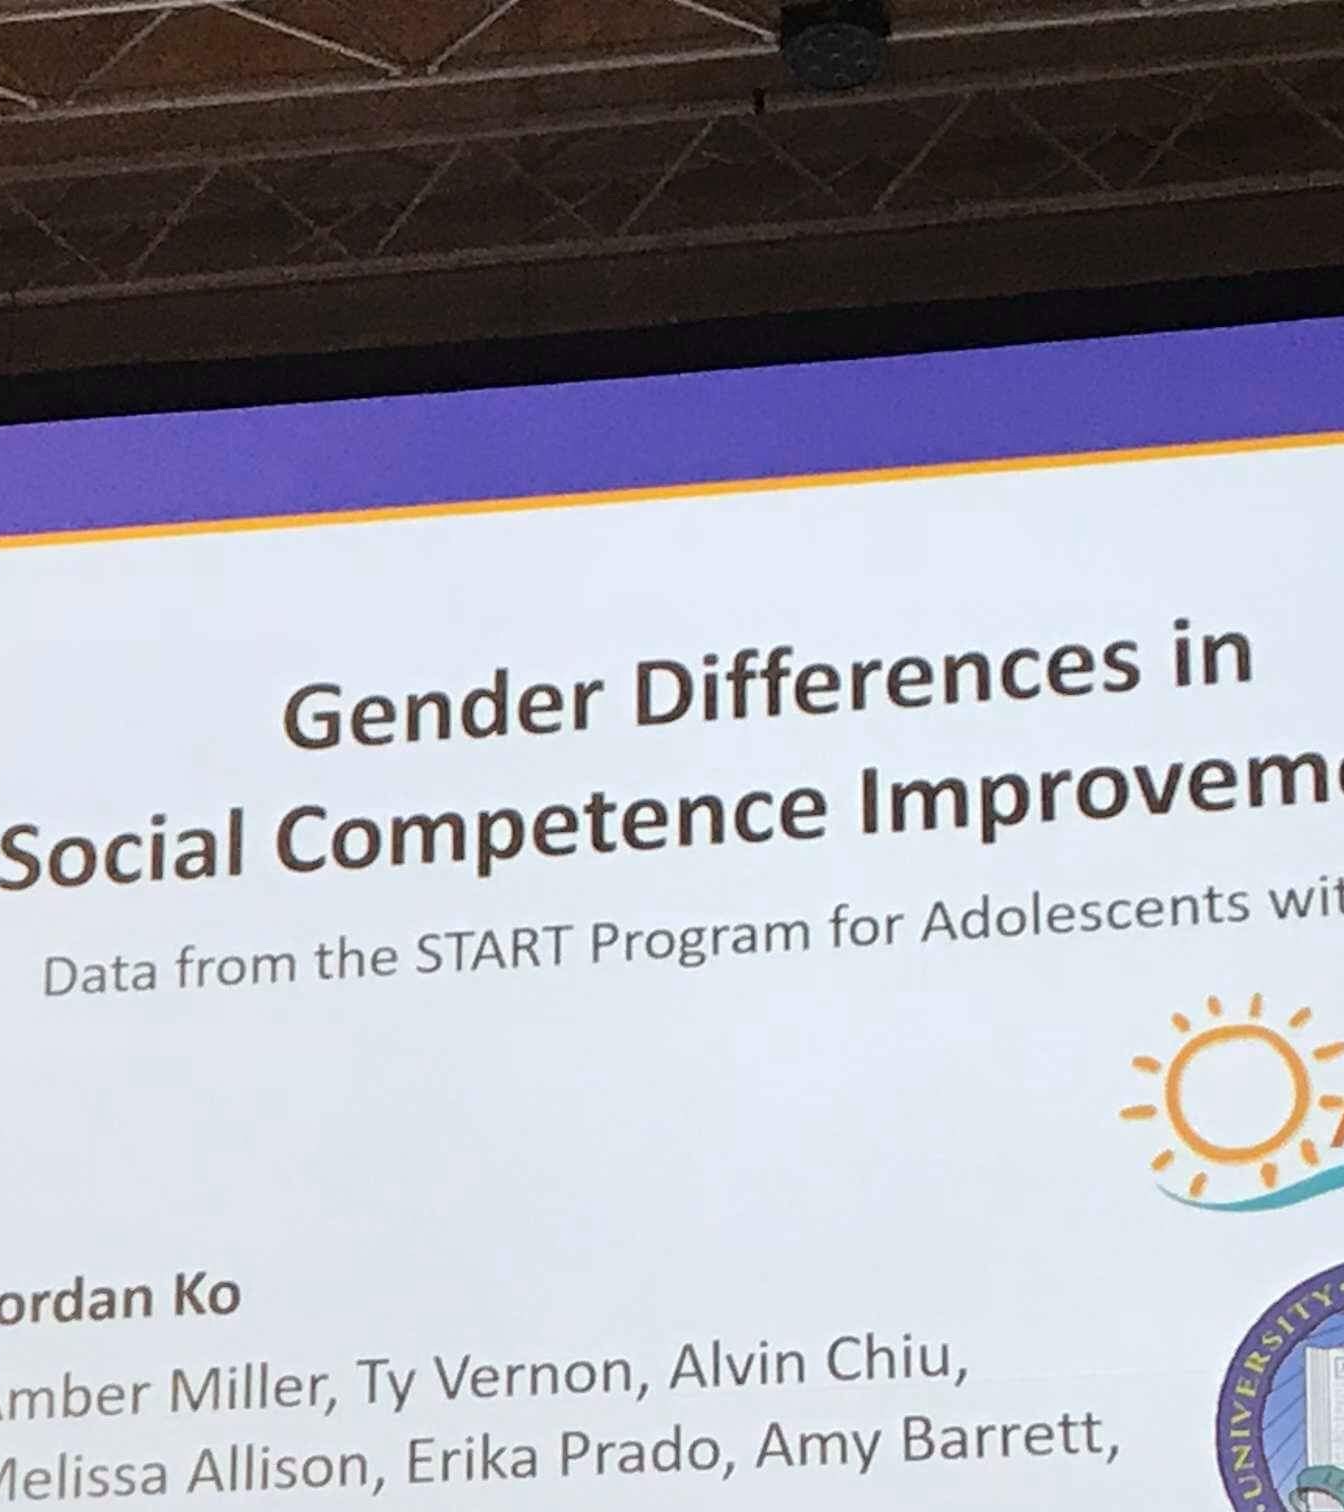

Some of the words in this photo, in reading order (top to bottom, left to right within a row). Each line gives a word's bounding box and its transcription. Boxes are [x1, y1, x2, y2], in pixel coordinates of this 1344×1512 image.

[284, 668, 604, 750] Gender
[637, 640, 1140, 726] Differences
[1174, 618, 1252, 687] in
[277, 788, 827, 878] Competence
[45, 956, 156, 996] Data
[176, 945, 296, 988] from
[315, 935, 398, 980] the
[416, 925, 573, 973] START
[592, 921, 809, 968] Program
[829, 904, 904, 947] for
[921, 886, 1250, 942] Adolescents
[175, 1272, 240, 1316] Ko
[171, 1362, 336, 1416] Miller,
[357, 1359, 416, 1413] Ty
[434, 1355, 648, 1401] Vernon,
[670, 1340, 804, 1389] Alvin
[828, 1333, 967, 1387] Chiu,
[1229, 1282, 1335, 1502] UNIVERSITY
[187, 1444, 384, 1496] Allison,
[409, 1432, 537, 1483] Erika
[562, 1424, 734, 1480] Prado,
[756, 1422, 881, 1474] Amy
[904, 1412, 1118, 1464] Barrett,
